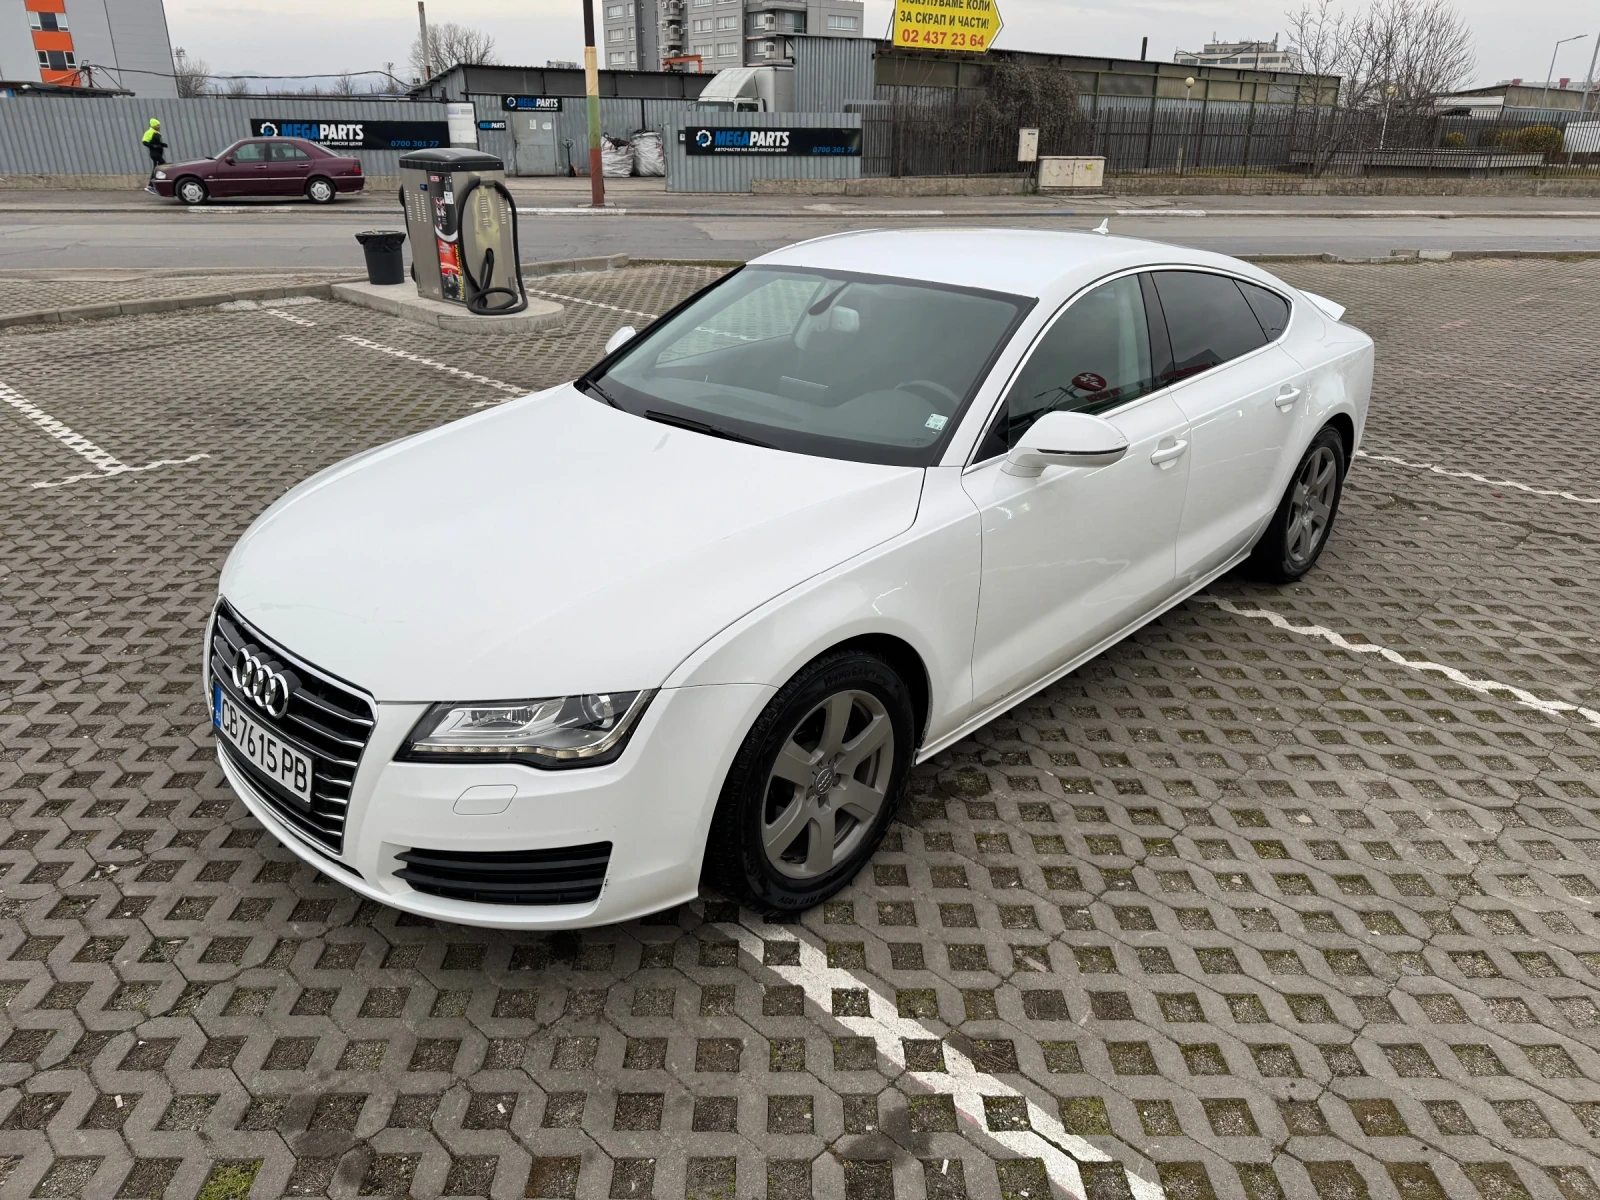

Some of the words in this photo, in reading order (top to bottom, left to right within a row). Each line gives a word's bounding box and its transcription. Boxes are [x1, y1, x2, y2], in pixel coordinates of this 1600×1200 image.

[902, 0, 964, 9] ПУВАМЕ
[966, 0, 991, 12] КОЛИ
[900, 10, 912, 23] ЗА
[916, 12, 947, 26] СКРАП
[949, 15, 956, 27] И
[958, 16, 990, 29] ЧАСТИ!
[902, 29, 919, 43] 02
[923, 31, 947, 45] 437
[951, 32, 966, 46] 23
[970, 34, 984, 48] 64
[517, 98, 558, 108] MEGAPARTS
[281, 123, 364, 140] MEGAPARTS
[714, 130, 790, 147] MEGAPARTS
